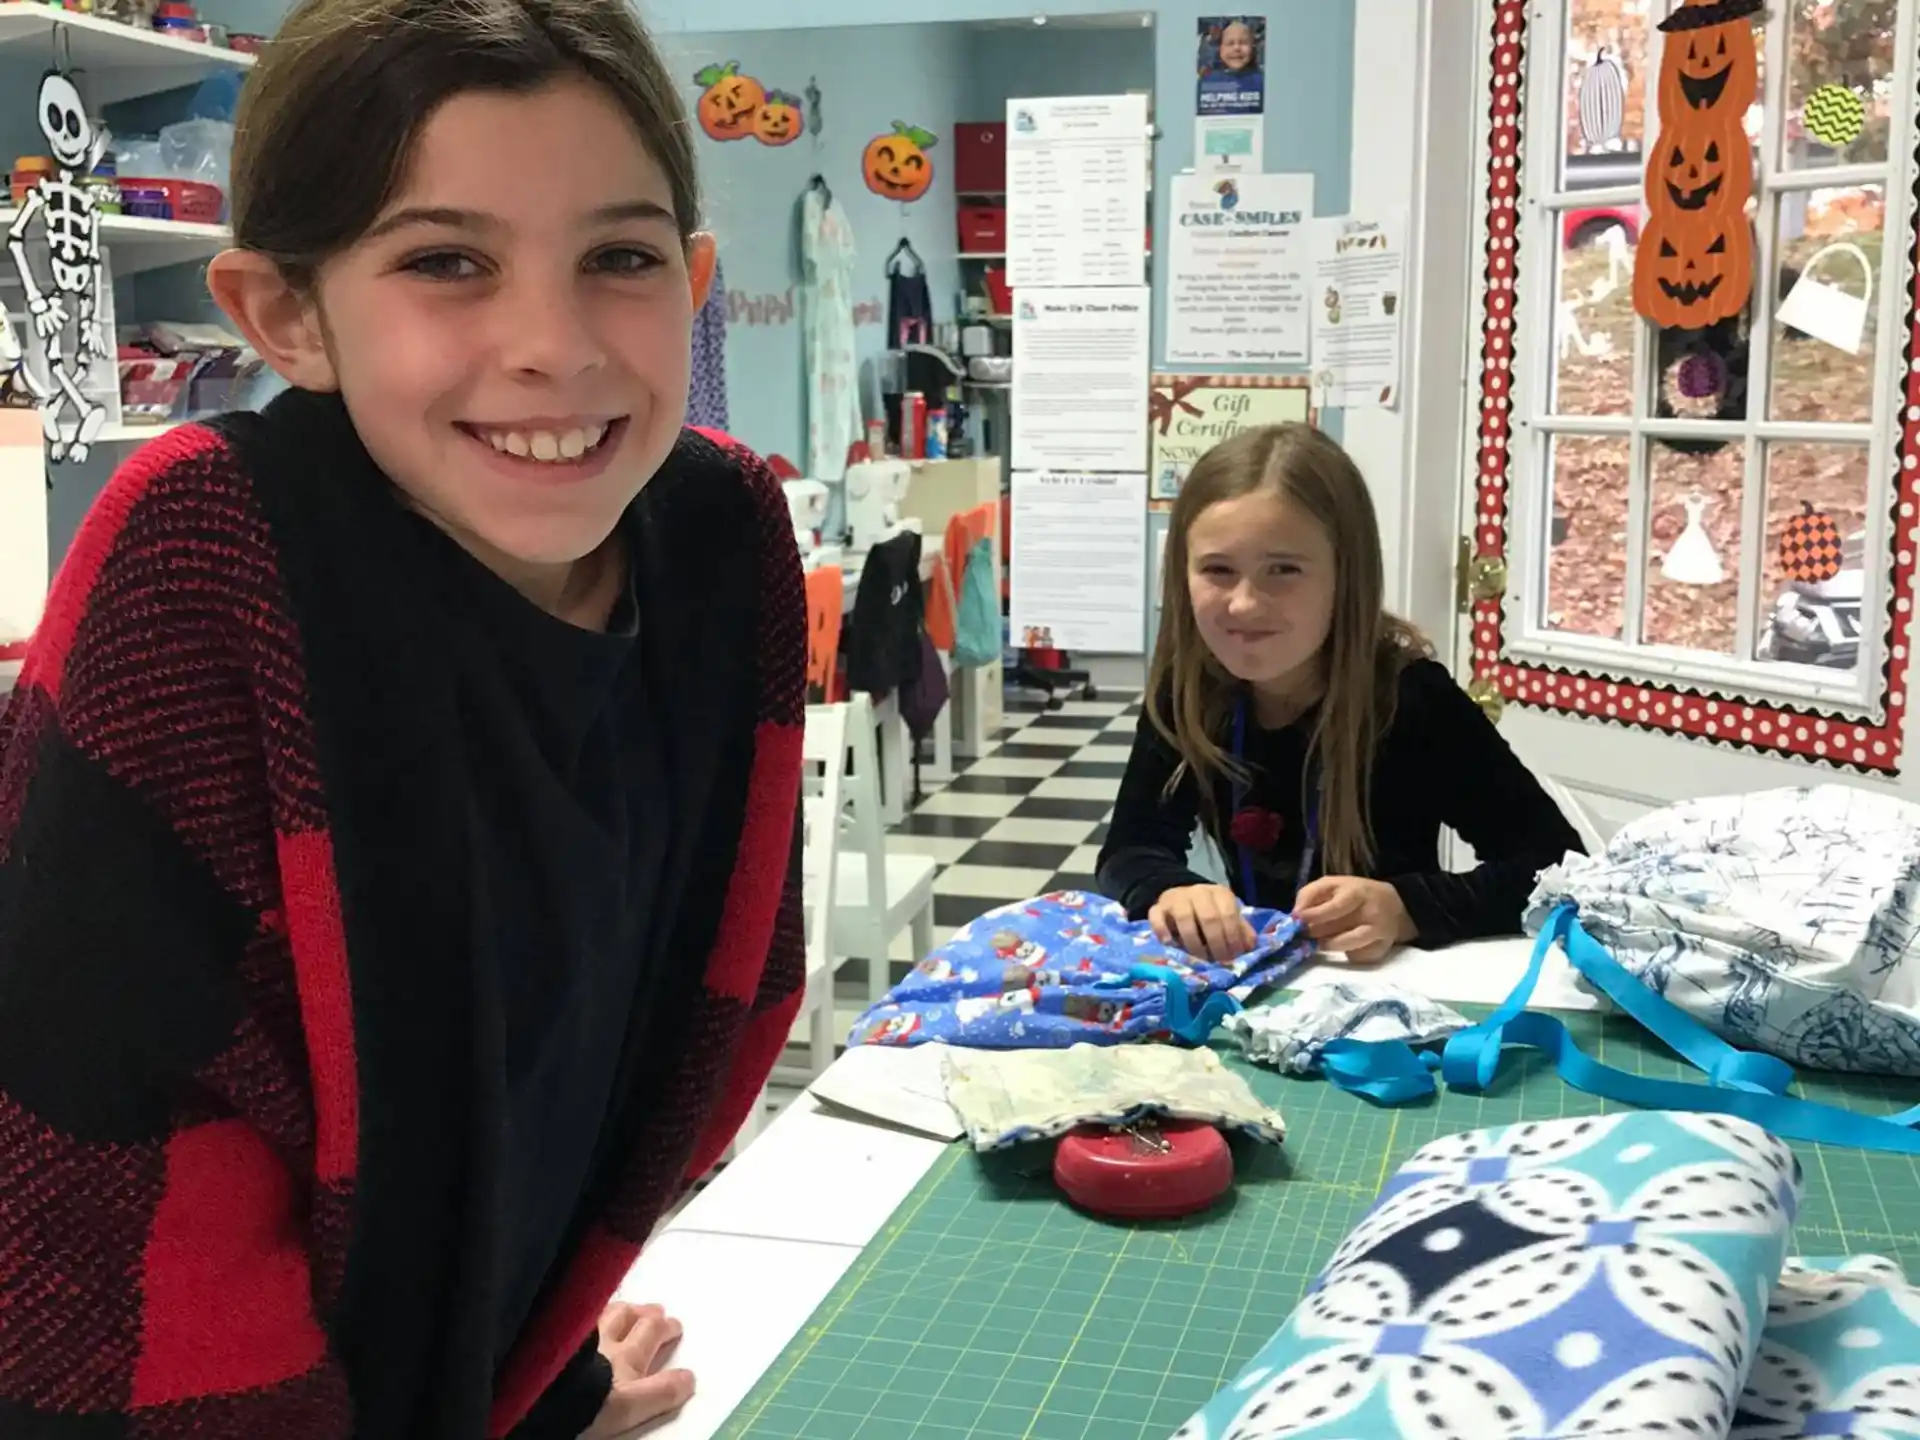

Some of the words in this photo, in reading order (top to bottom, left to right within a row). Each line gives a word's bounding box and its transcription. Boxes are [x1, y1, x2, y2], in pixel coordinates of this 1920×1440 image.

[1179, 212, 1224, 226] CASE
[1235, 210, 1302, 225] SMILES
[1212, 393, 1253, 418] Gift
